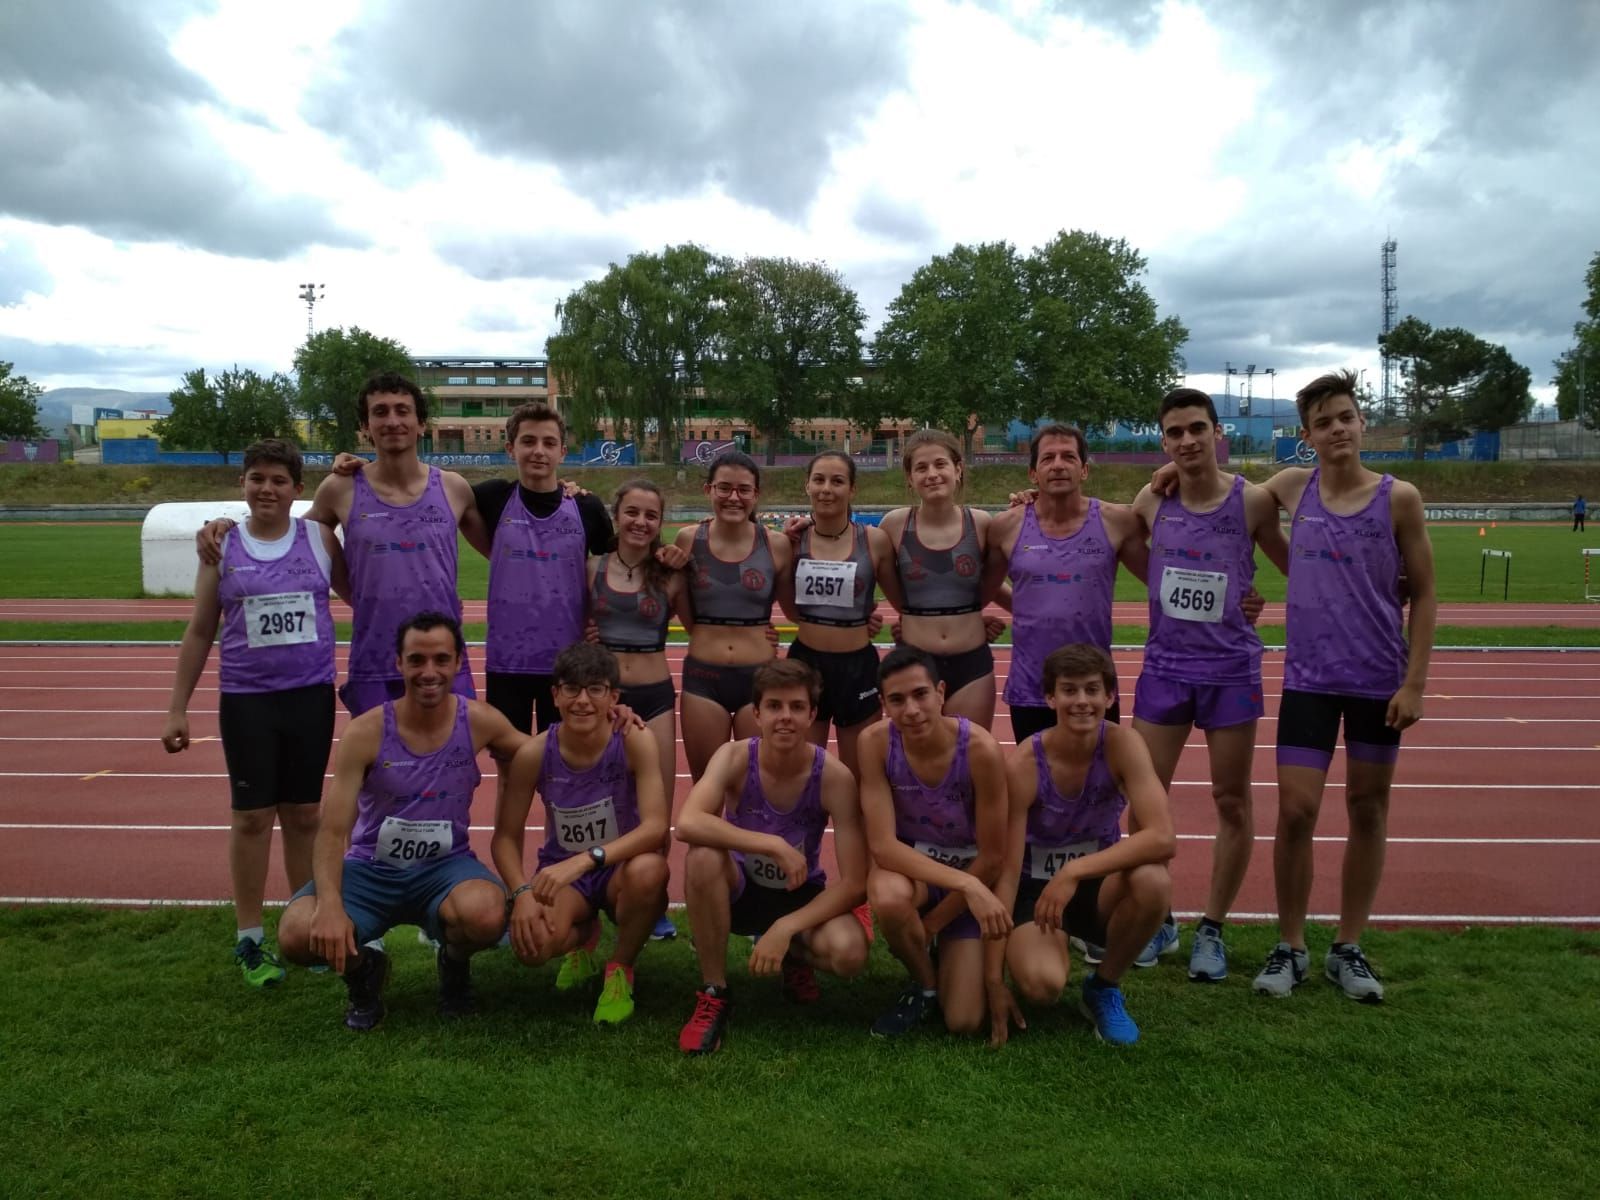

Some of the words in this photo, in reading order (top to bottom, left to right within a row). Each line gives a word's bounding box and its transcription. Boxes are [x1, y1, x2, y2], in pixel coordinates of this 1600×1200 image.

[805, 575, 845, 597] 2557
[1169, 586, 1215, 612] 4569
[259, 611, 306, 635] 2987
[561, 818, 607, 843] 2617
[389, 838, 441, 860] 2602
[1044, 852, 1087, 877] 47
